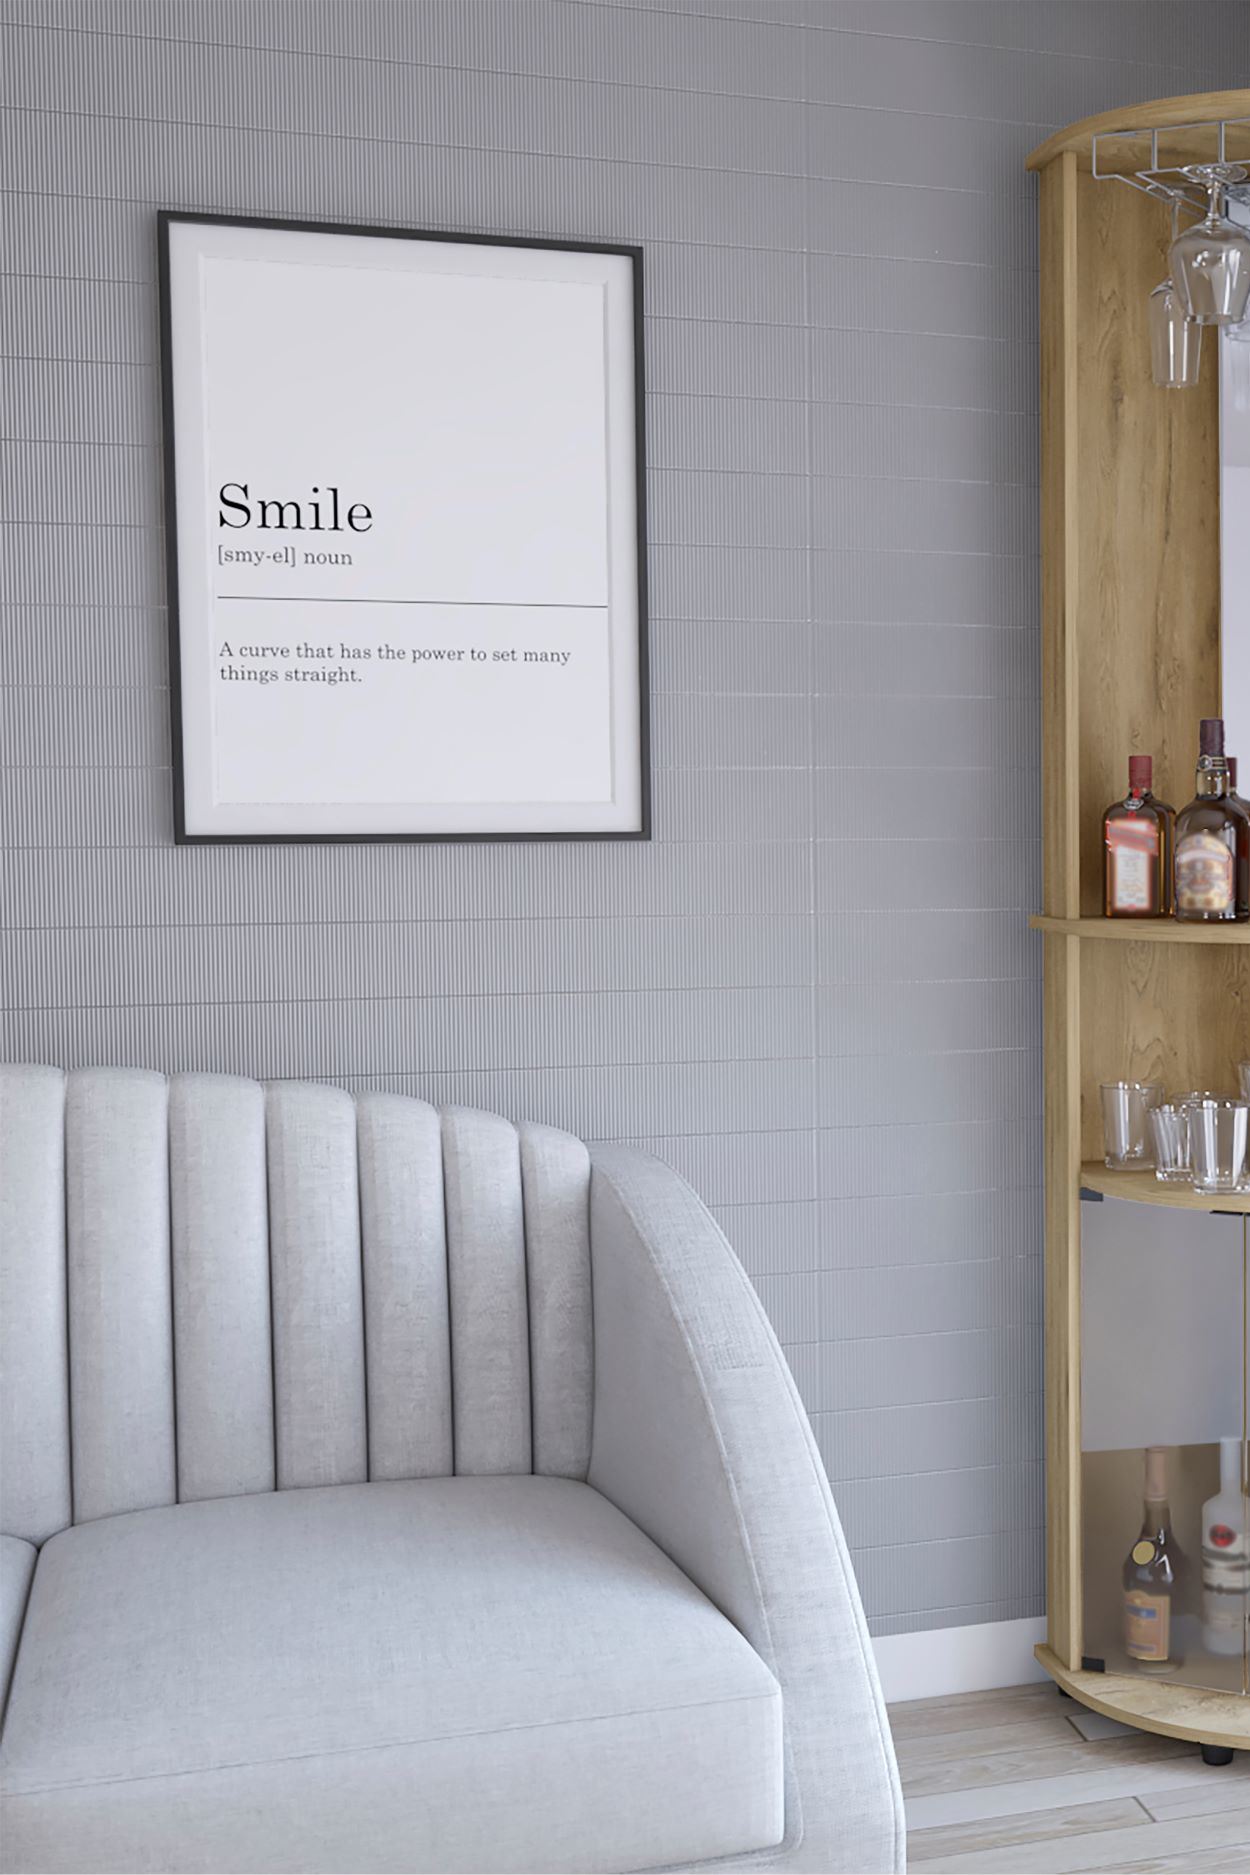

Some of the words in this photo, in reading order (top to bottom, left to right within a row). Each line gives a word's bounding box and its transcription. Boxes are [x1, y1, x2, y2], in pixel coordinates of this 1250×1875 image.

[219, 483, 372, 532] Smile
[218, 545, 296, 567] [smy-el]
[304, 552, 352, 566] noun
[219, 641, 234, 657] A
[239, 646, 290, 659] curve
[296, 642, 335, 659] that
[340, 643, 371, 660] has
[377, 644, 406, 660] the
[412, 649, 465, 664] power
[471, 648, 487, 661] to
[492, 648, 518, 661] set
[524, 650, 571, 666] many
[220, 664, 279, 685] things
[285, 666, 362, 687] straight.
